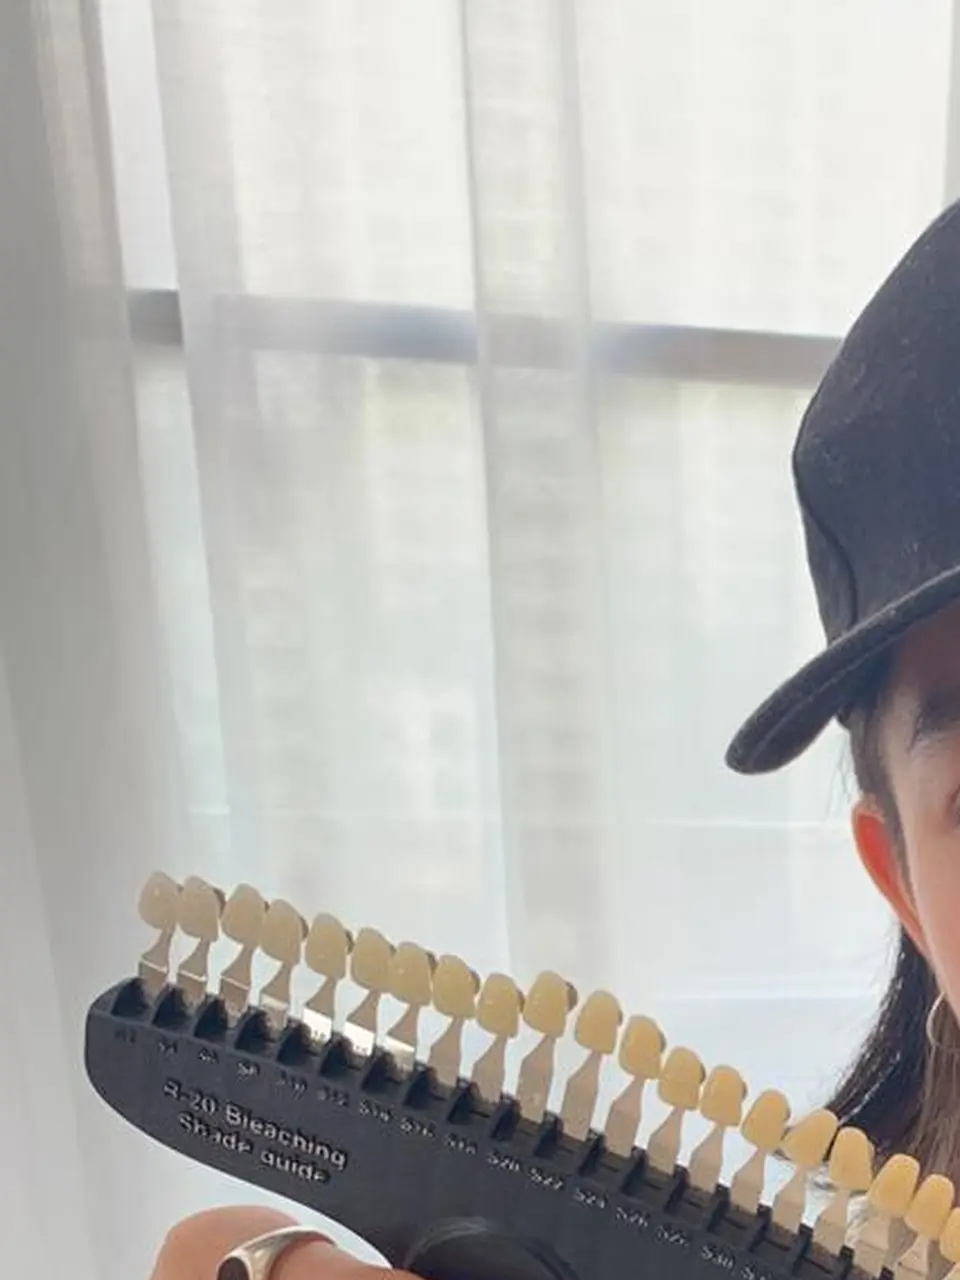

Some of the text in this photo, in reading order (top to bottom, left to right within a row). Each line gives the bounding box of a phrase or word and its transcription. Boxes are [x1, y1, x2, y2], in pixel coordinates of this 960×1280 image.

[177, 1111, 331, 1185] Shade guide
[224, 1101, 350, 1169] Bleaching
